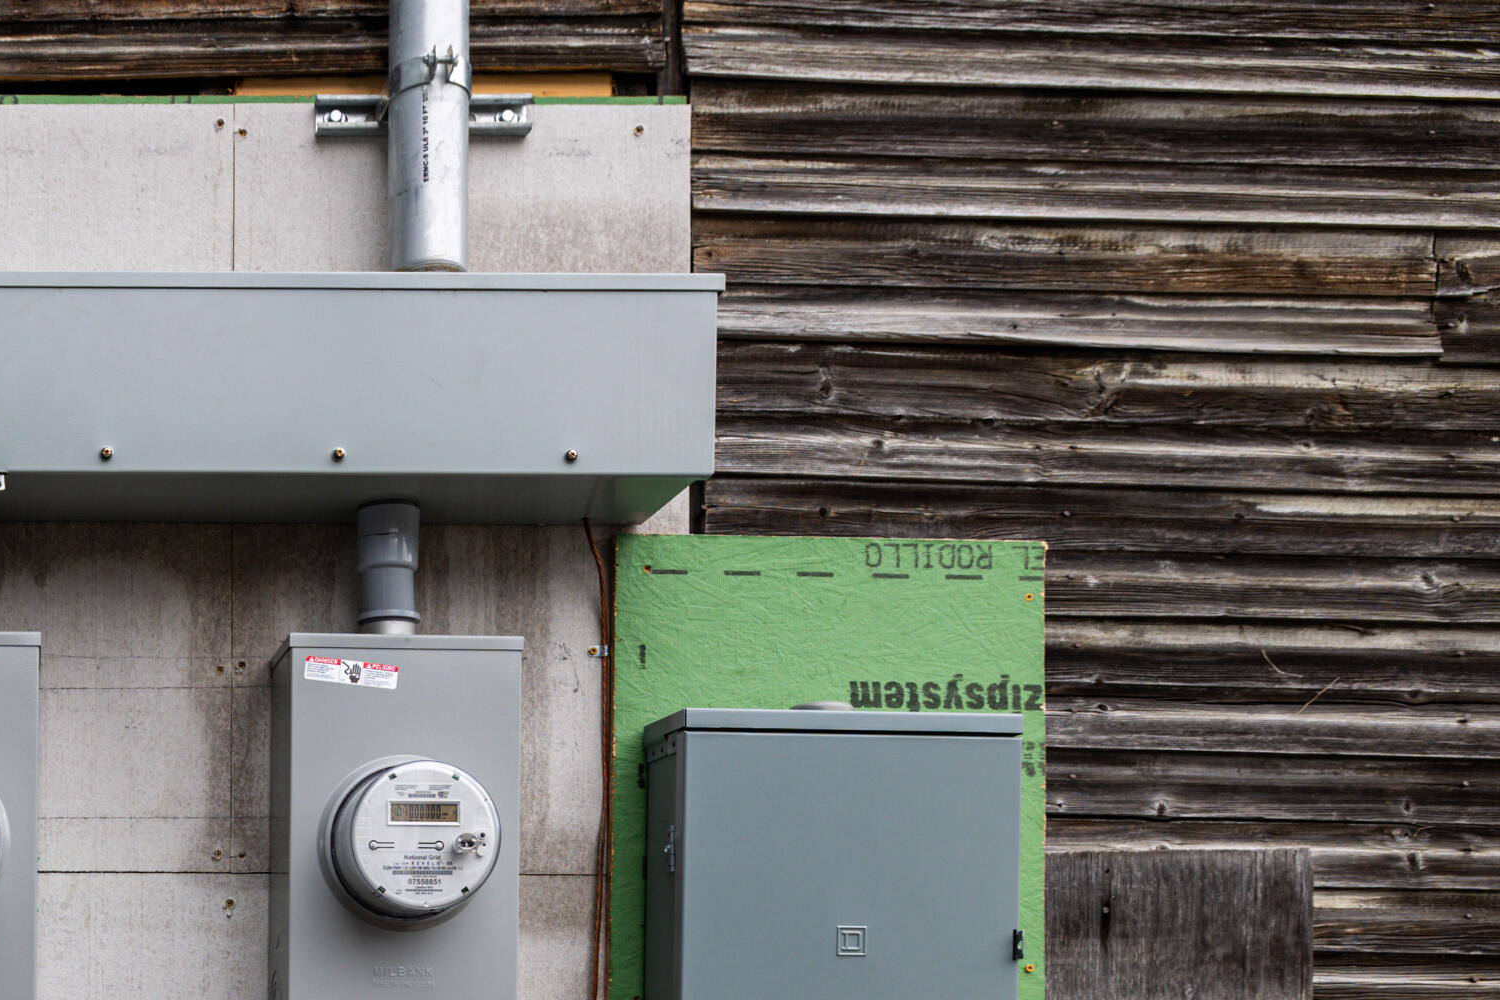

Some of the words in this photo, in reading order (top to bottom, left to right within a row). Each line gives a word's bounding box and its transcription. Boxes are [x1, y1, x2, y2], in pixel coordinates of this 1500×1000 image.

[865, 543, 993, 570] RODILLO
[371, 663, 396, 672] PELIGRO
[850, 674, 1043, 713] zipsystem
[373, 966, 435, 977] MILBANK
